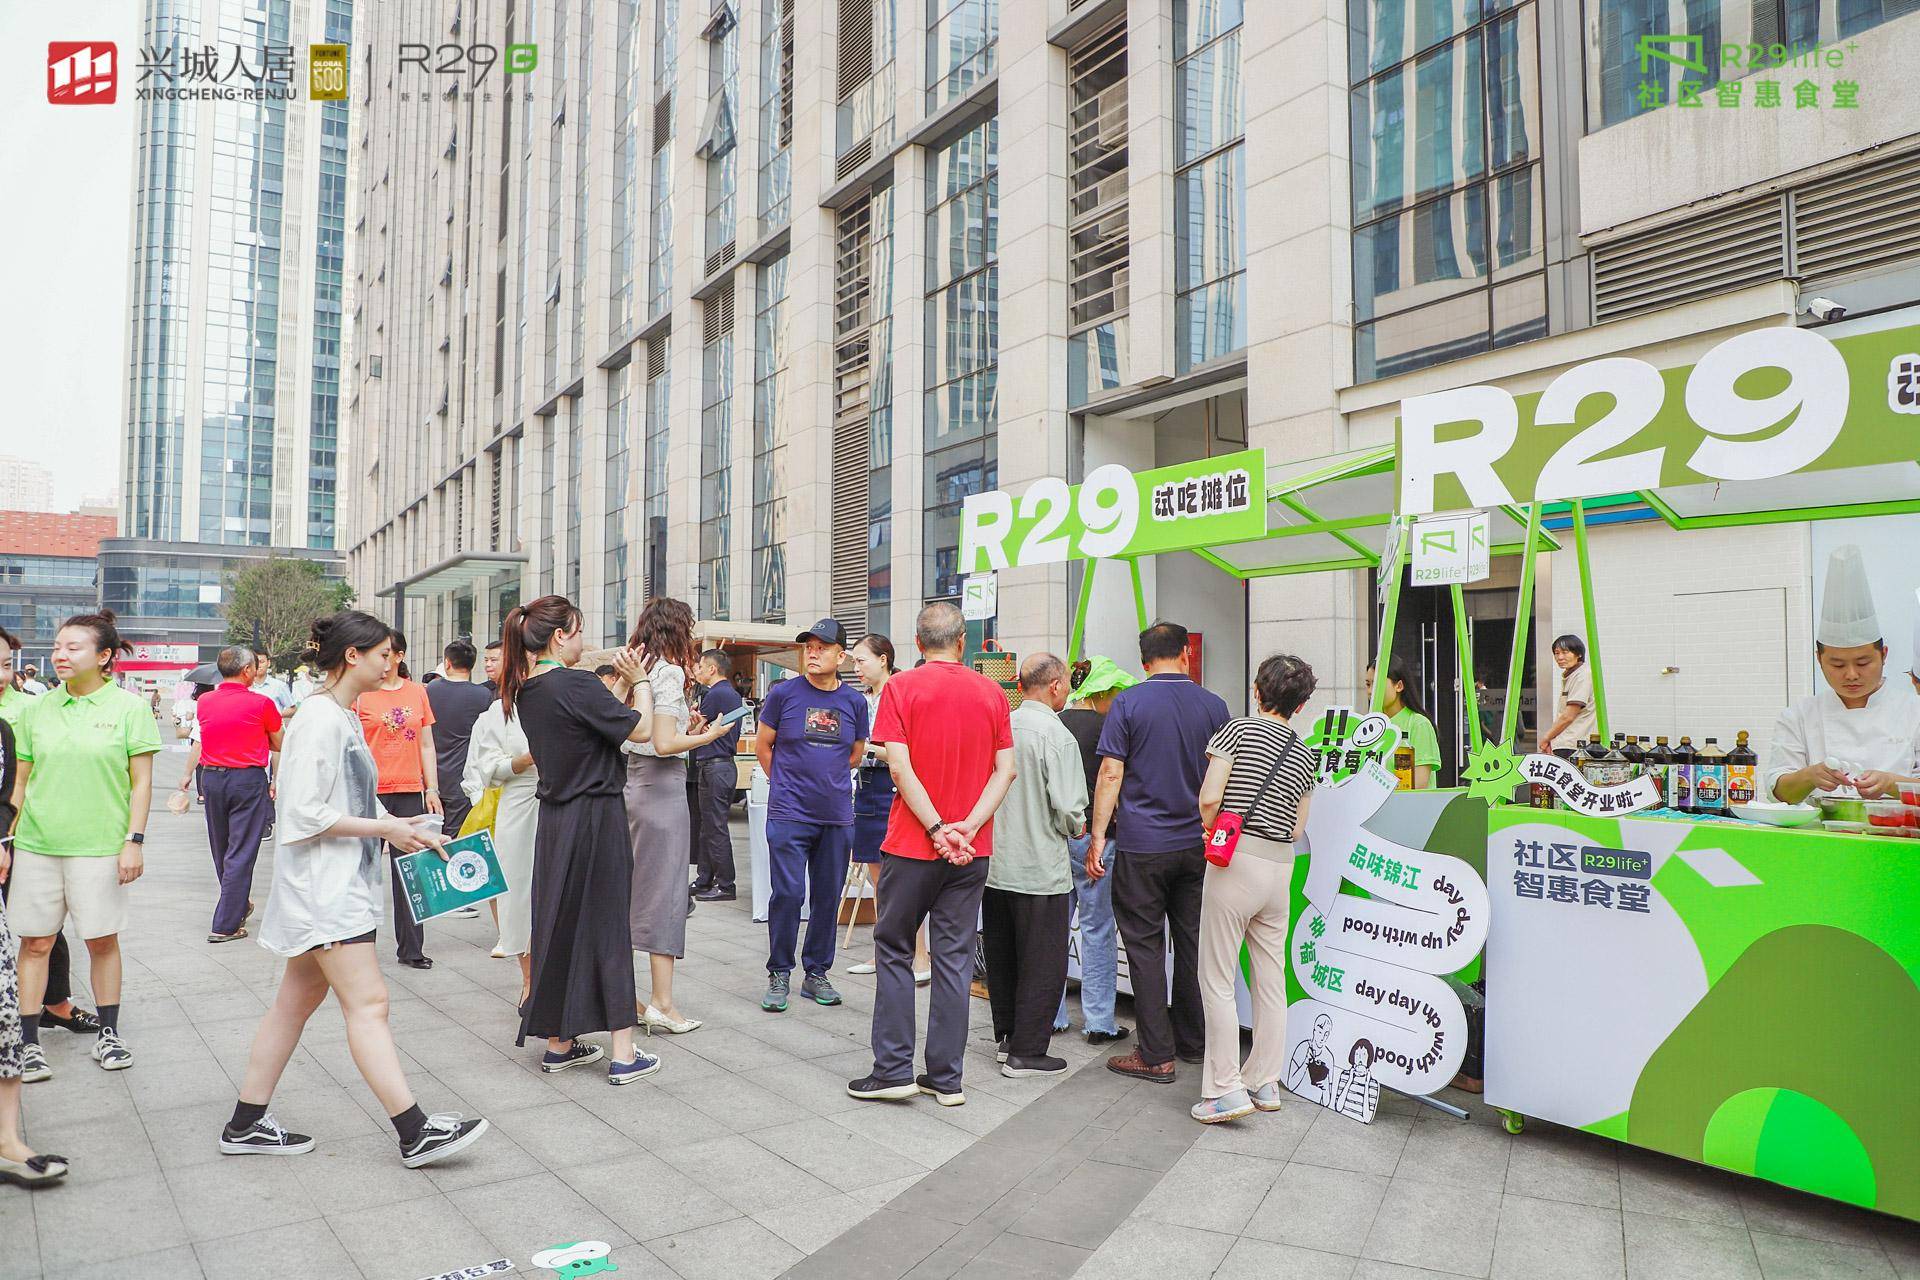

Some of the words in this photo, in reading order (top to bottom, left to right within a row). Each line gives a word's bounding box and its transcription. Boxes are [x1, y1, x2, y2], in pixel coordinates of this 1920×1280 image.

[1401, 326, 1850, 515] R29
[963, 464, 1139, 573] R29
[1153, 473, 1247, 517] 试吃摊位
[1348, 843, 1422, 891] 品味锦江
[1514, 838, 1579, 873] 社区
[1433, 875, 1464, 905] day
[1514, 870, 1651, 914] 智惠食堂
[1343, 917, 1380, 939] food
[1383, 926, 1417, 947] with
[1422, 931, 1443, 949] up
[1446, 907, 1471, 947] day
[1299, 915, 1345, 993] 幸福城区
[1355, 980, 1386, 1005] day
[1388, 989, 1421, 1016] day
[1422, 1003, 1442, 1029] up
[1375, 1046, 1414, 1075] food
[1416, 1031, 1446, 1074] with
